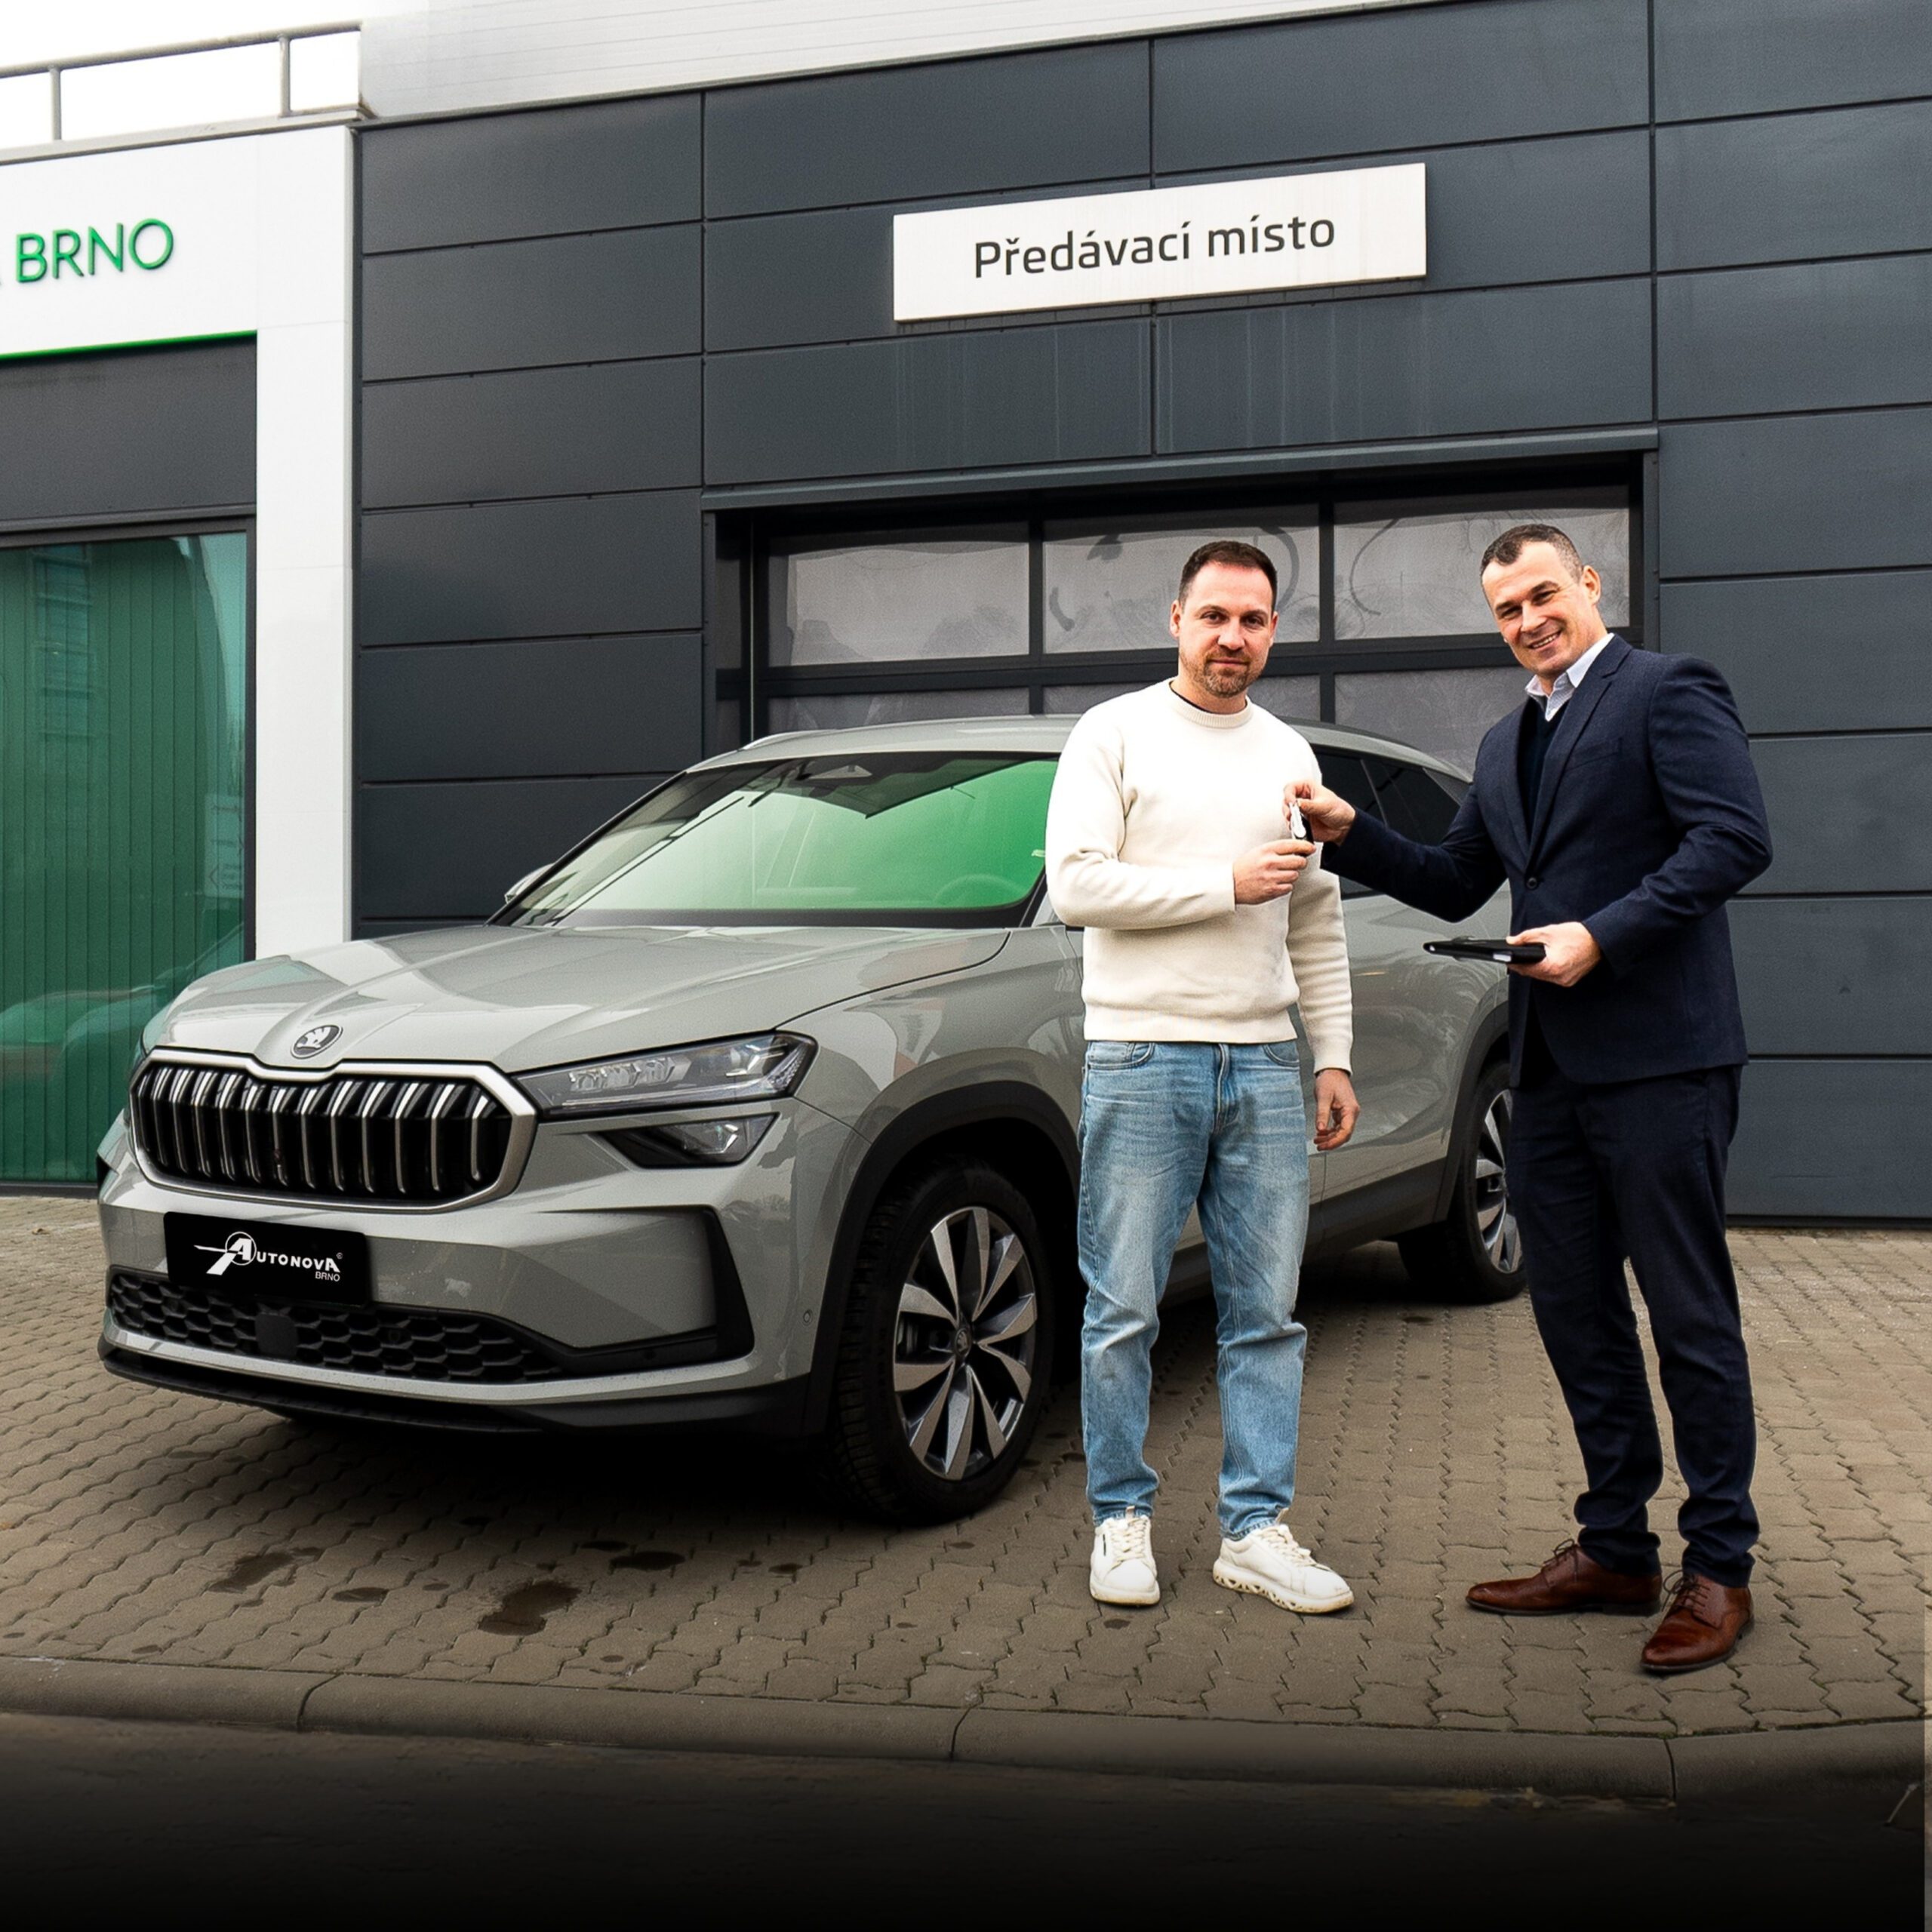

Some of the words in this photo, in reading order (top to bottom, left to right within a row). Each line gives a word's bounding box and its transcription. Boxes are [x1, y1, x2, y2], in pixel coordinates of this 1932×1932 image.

[16, 218, 174, 284] BRNO
[975, 221, 1191, 278] Předávací
[1208, 214, 1335, 257] místo
[315, 1271, 340, 1282] BRNO
